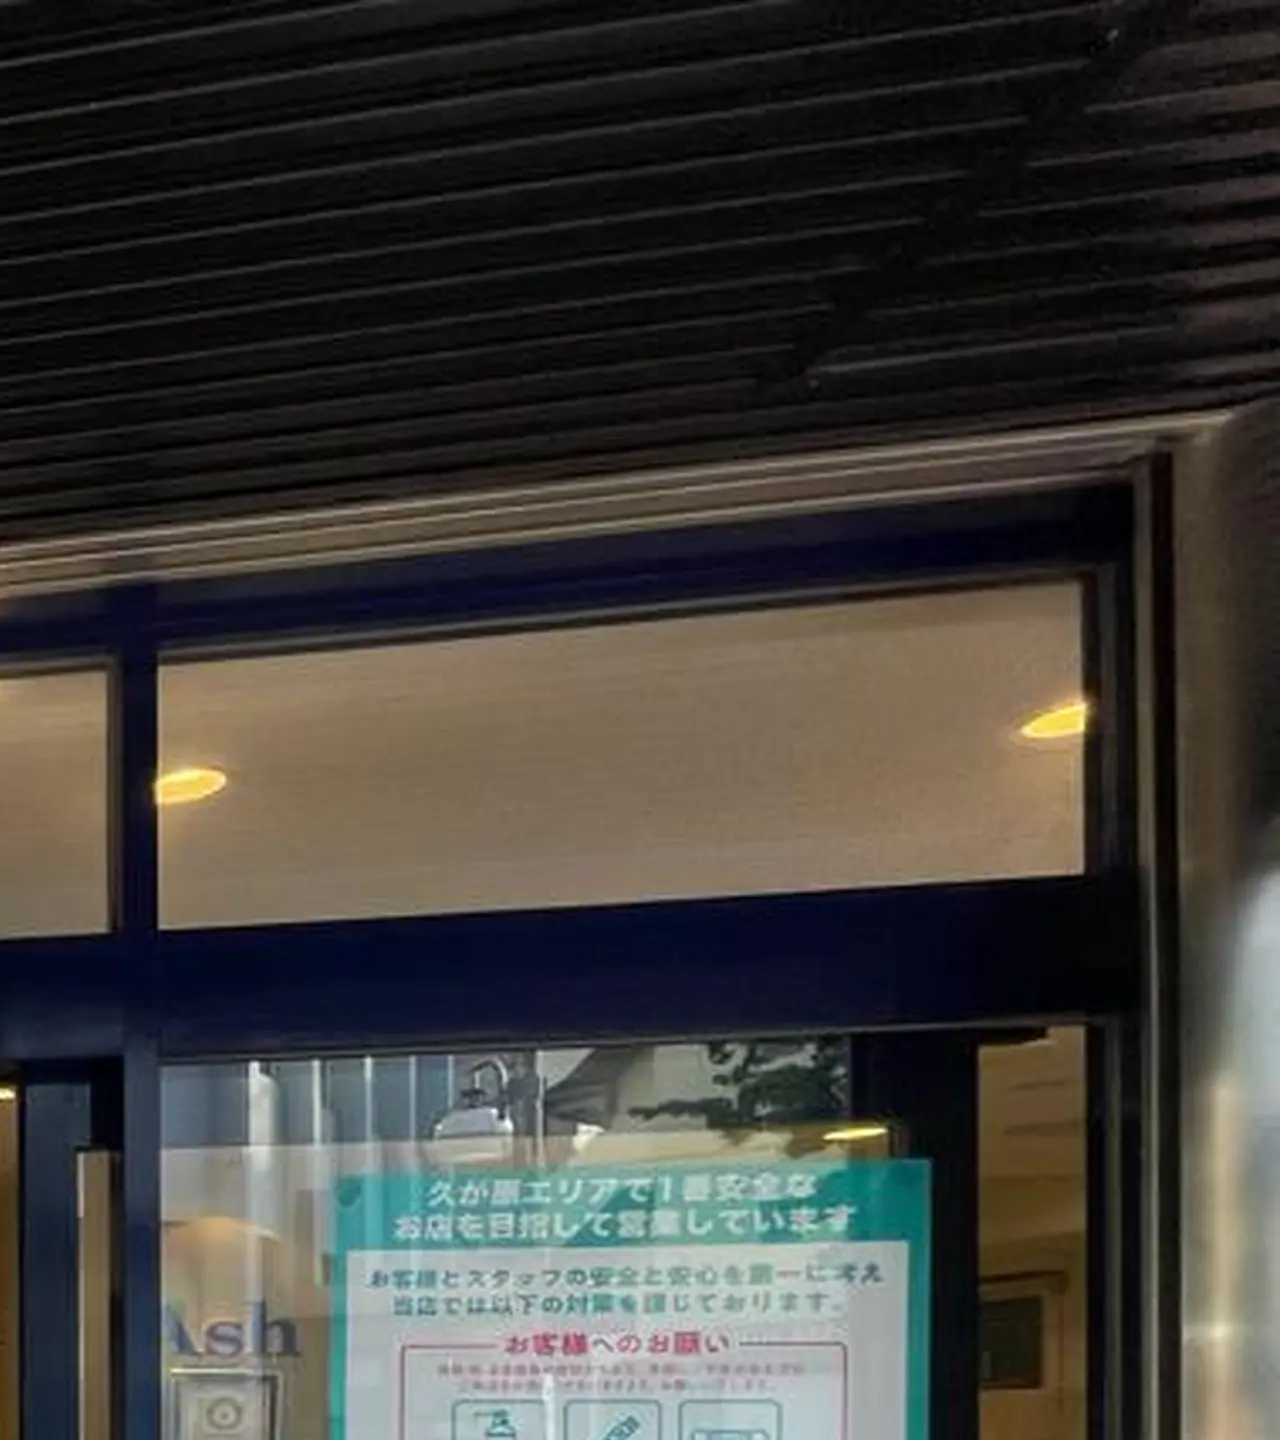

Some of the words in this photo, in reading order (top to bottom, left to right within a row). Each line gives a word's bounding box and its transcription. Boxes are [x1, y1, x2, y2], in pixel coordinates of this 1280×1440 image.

[504, 1331, 731, 1357] お客様へのお願い
